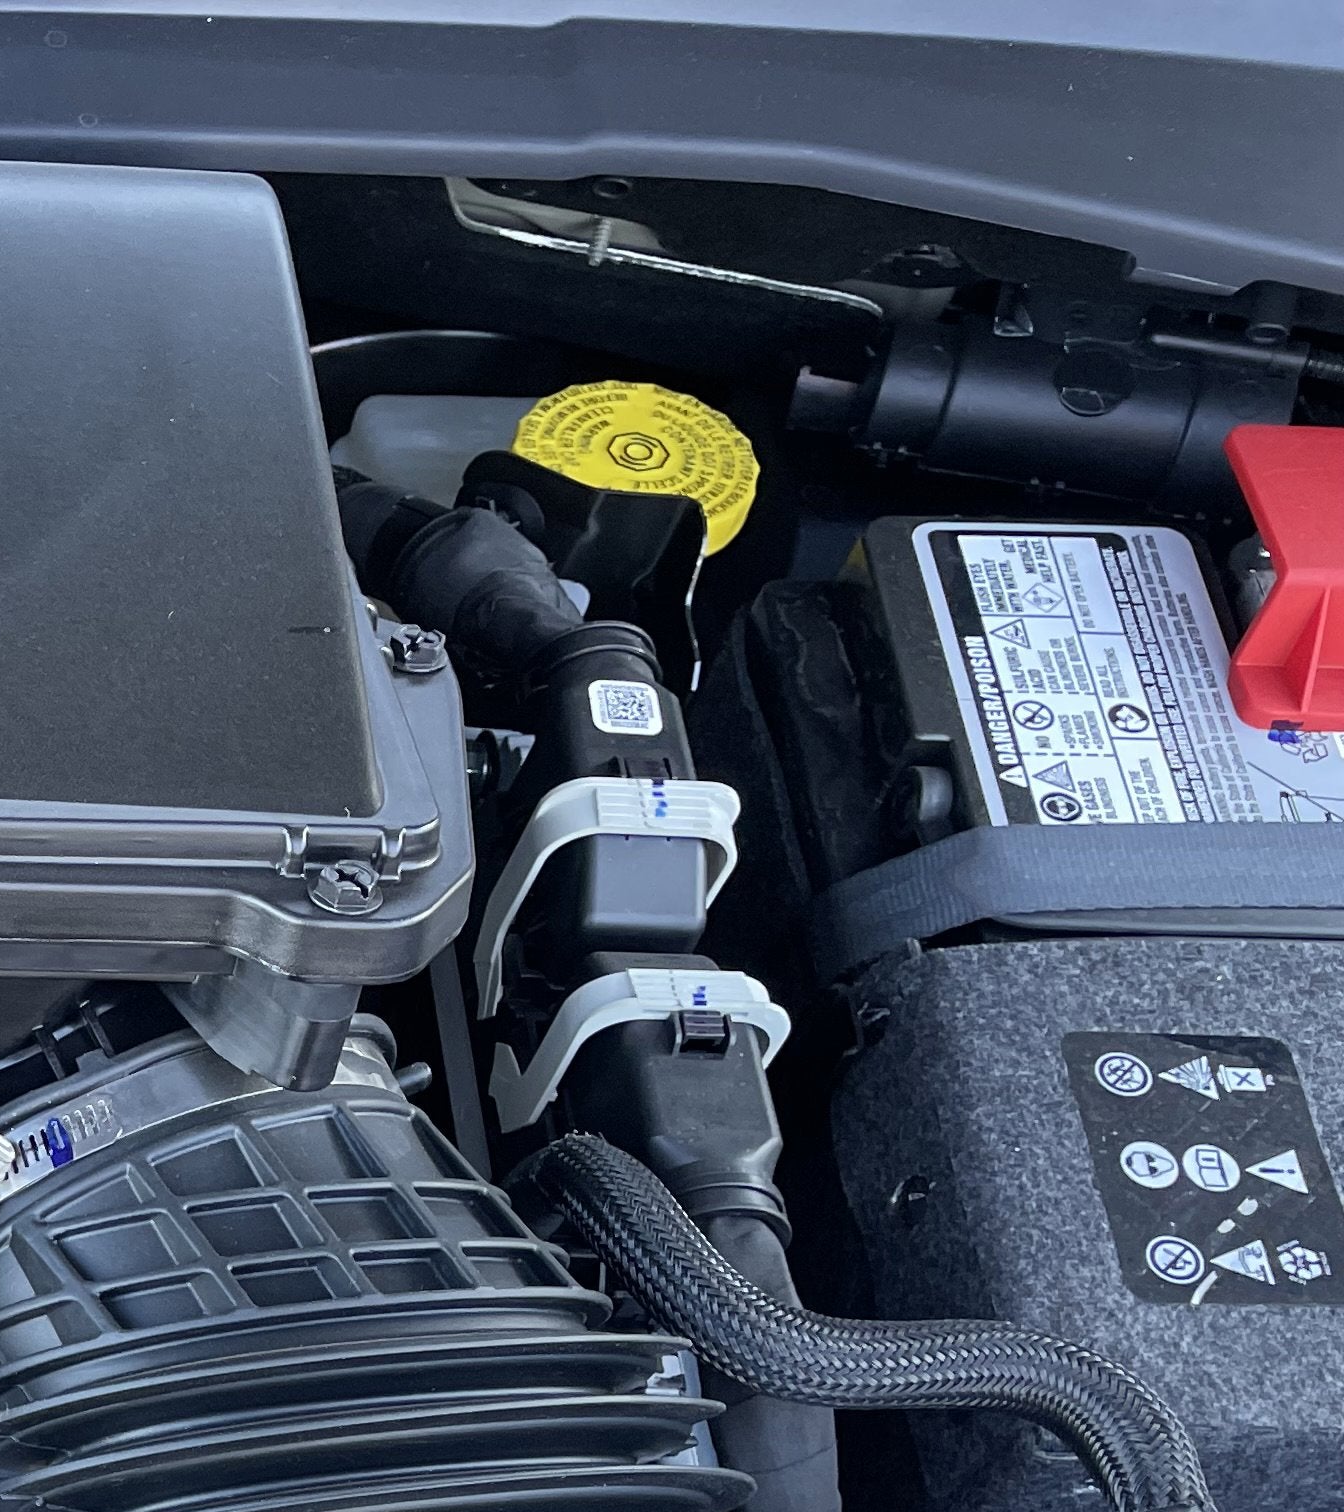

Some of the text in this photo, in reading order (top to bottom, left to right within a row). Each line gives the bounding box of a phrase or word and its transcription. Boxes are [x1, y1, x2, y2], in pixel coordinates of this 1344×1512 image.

[968, 563, 985, 583] EYES
[1002, 646, 1029, 688] SULFURIC
[1027, 668, 1045, 688] ACID
[962, 636, 1019, 764] DANGER/POISON
[1034, 735, 1052, 748] NO
